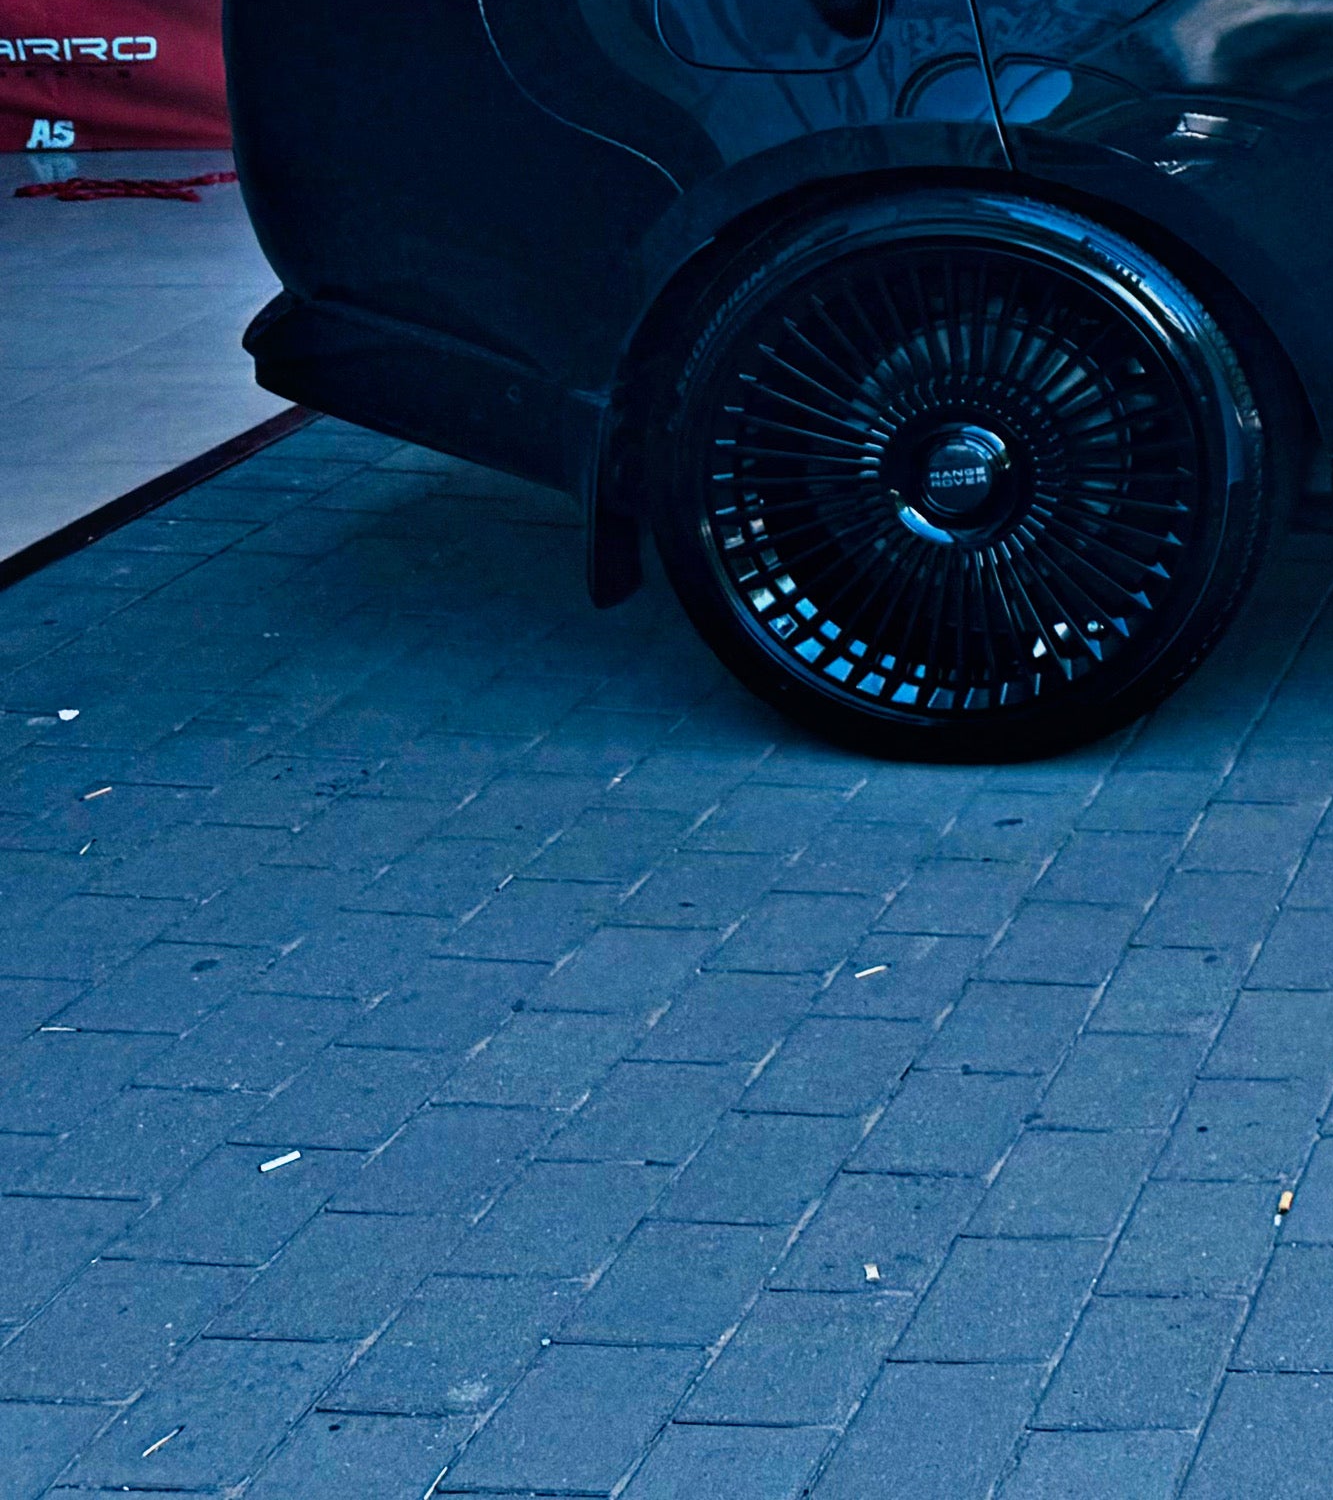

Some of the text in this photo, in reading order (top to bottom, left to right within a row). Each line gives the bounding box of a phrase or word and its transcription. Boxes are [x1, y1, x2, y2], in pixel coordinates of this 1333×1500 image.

[26, 118, 76, 149] AS
[929, 466, 986, 479] RANGE
[931, 475, 988, 488] ROVER
